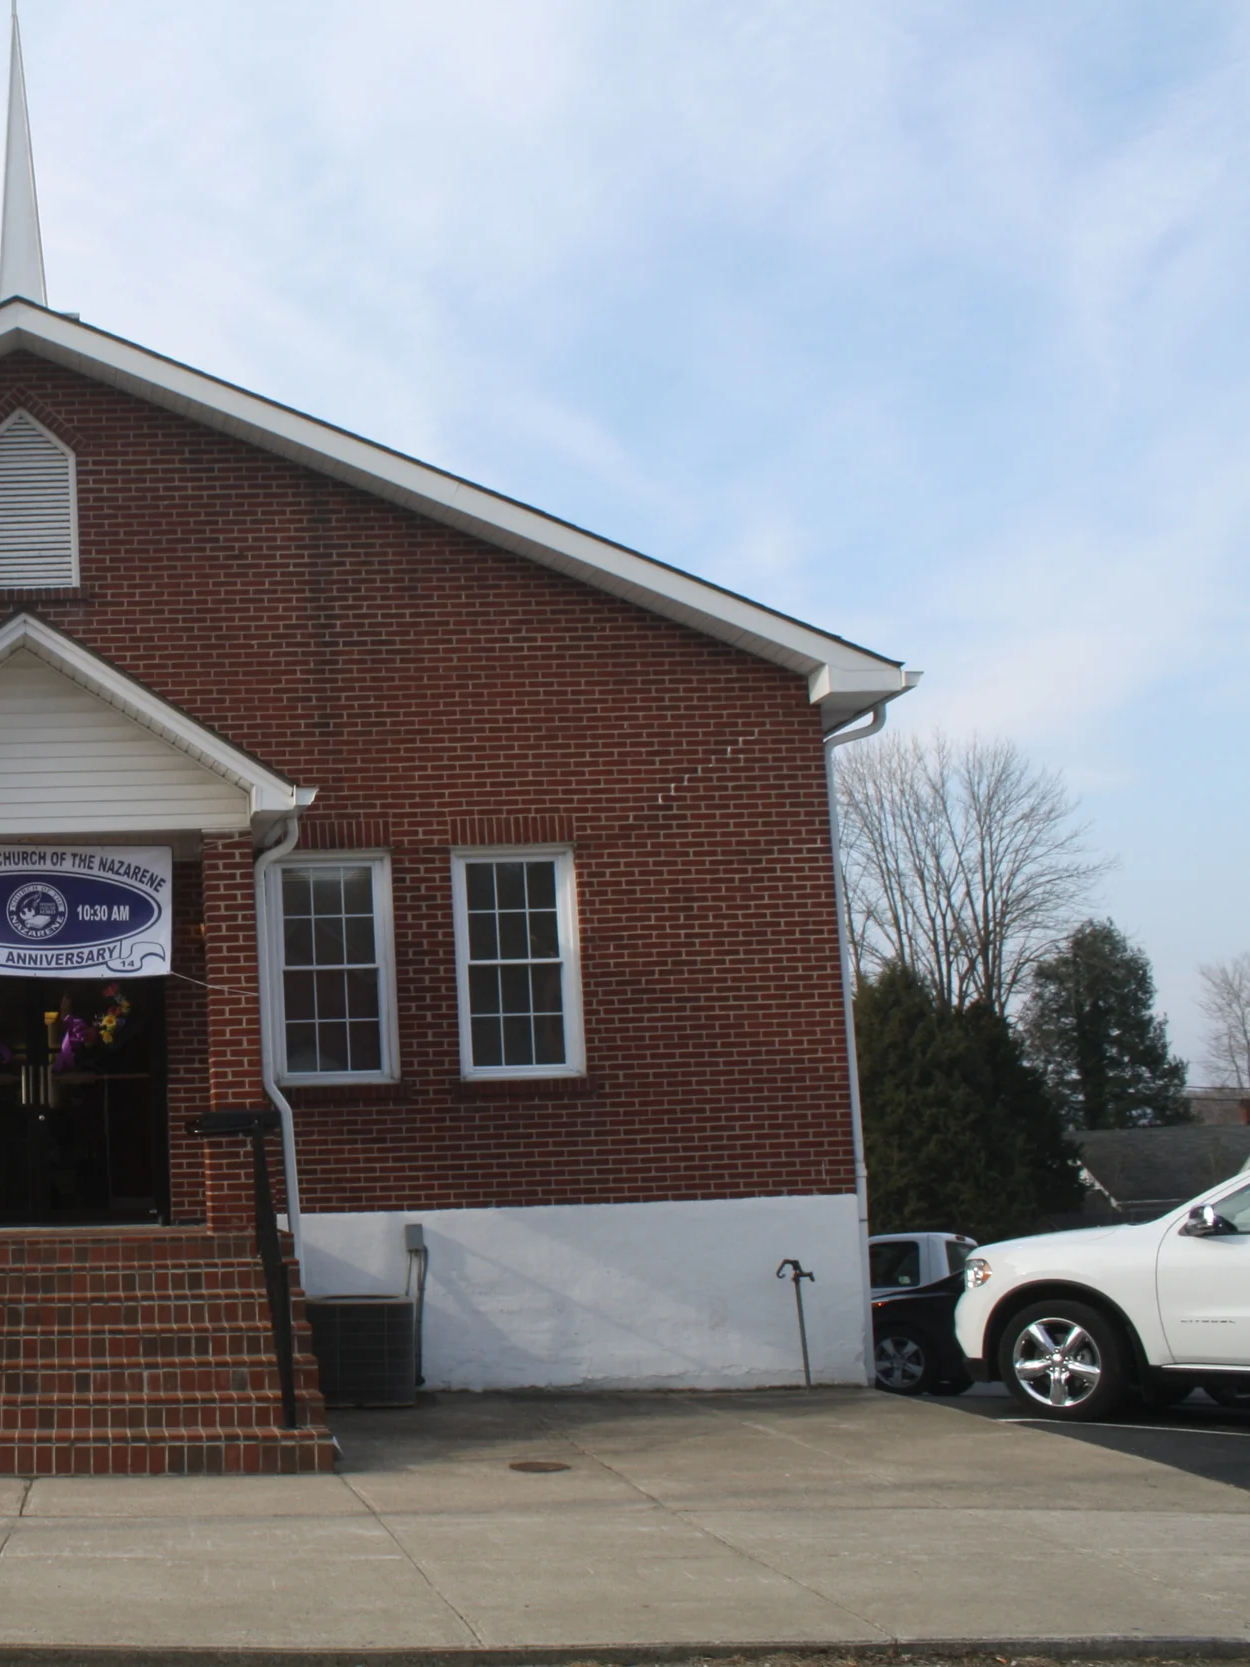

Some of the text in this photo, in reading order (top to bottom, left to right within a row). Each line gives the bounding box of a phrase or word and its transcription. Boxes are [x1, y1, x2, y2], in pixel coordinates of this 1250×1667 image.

[50, 851, 67, 867] OF
[71, 853, 96, 870] THE
[97, 857, 167, 893] NAZARENE
[76, 904, 130, 921] 10:30 AM
[10, 915, 64, 937] NAZARENE
[5, 944, 118, 967] ANNIVERSARY
[120, 960, 135, 968] 14
